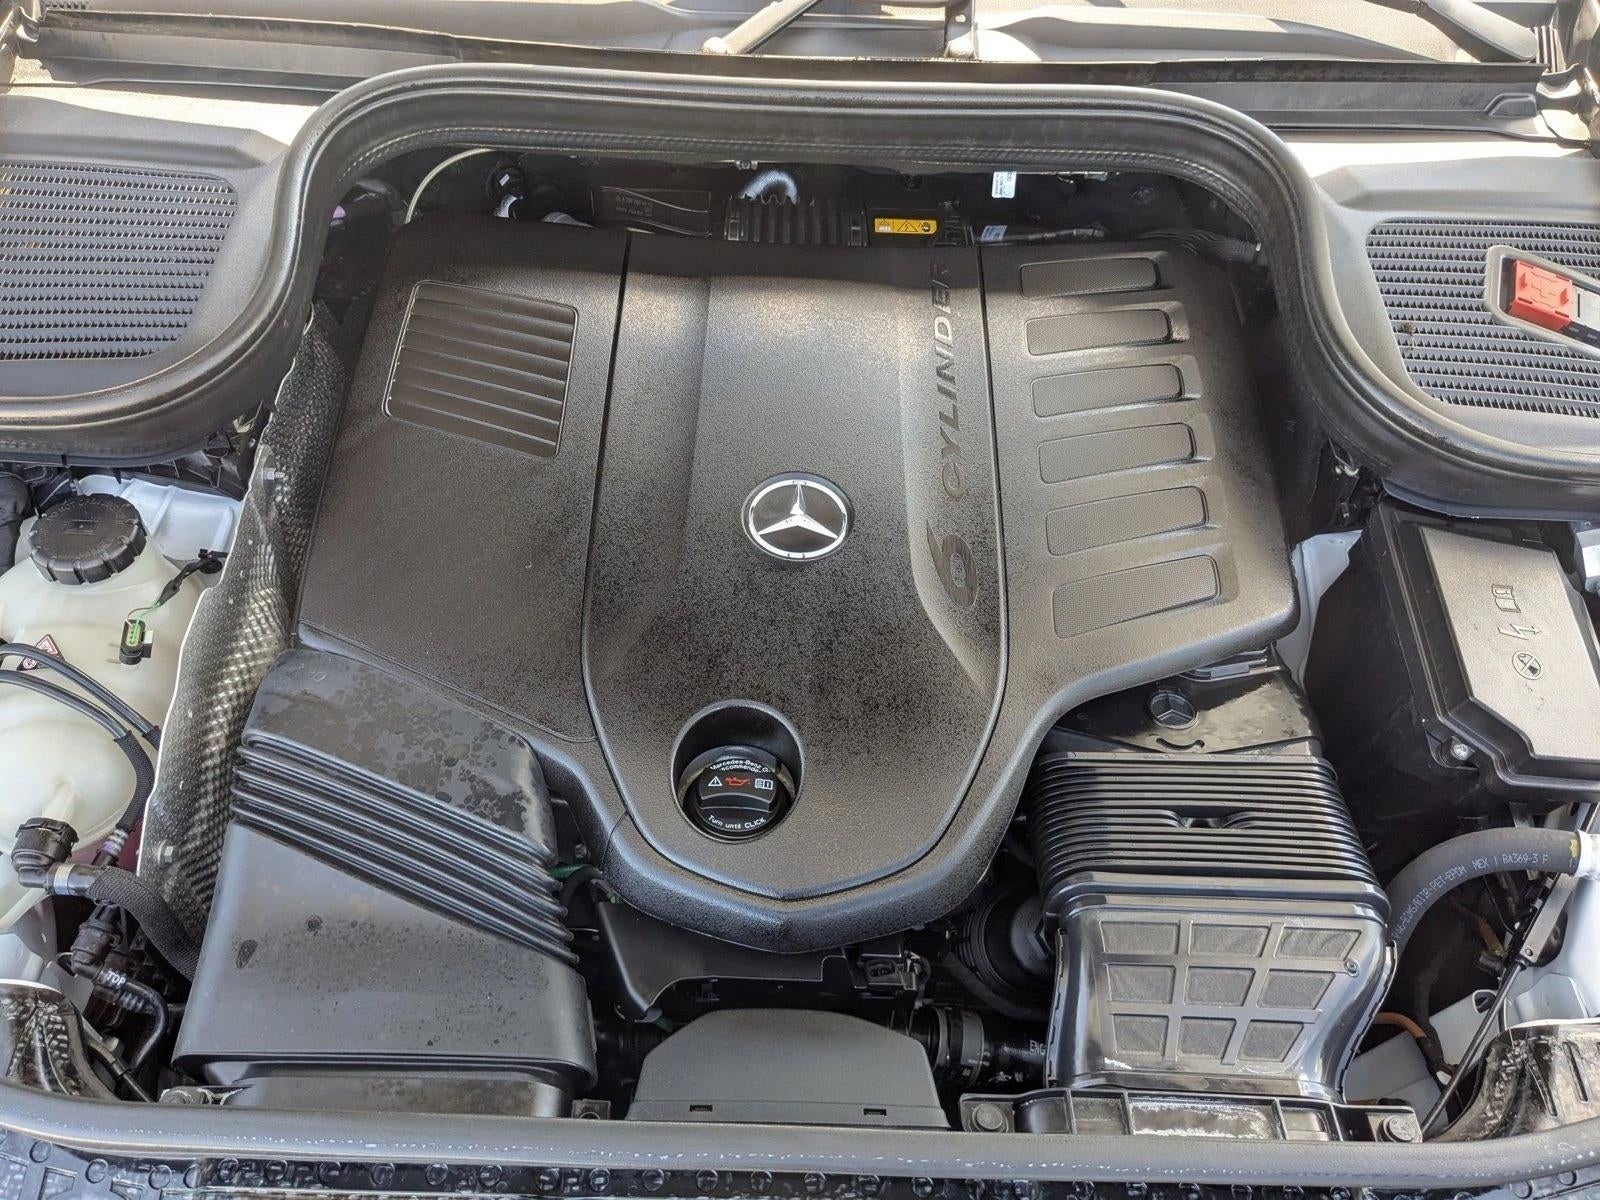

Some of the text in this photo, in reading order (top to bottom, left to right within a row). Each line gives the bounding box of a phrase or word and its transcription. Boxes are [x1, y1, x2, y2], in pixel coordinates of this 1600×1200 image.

[930, 258, 963, 501] CYLINDER
[708, 814, 723, 826] Turn
[744, 817, 767, 829] CLICK
[106, 970, 126, 985] TOP
